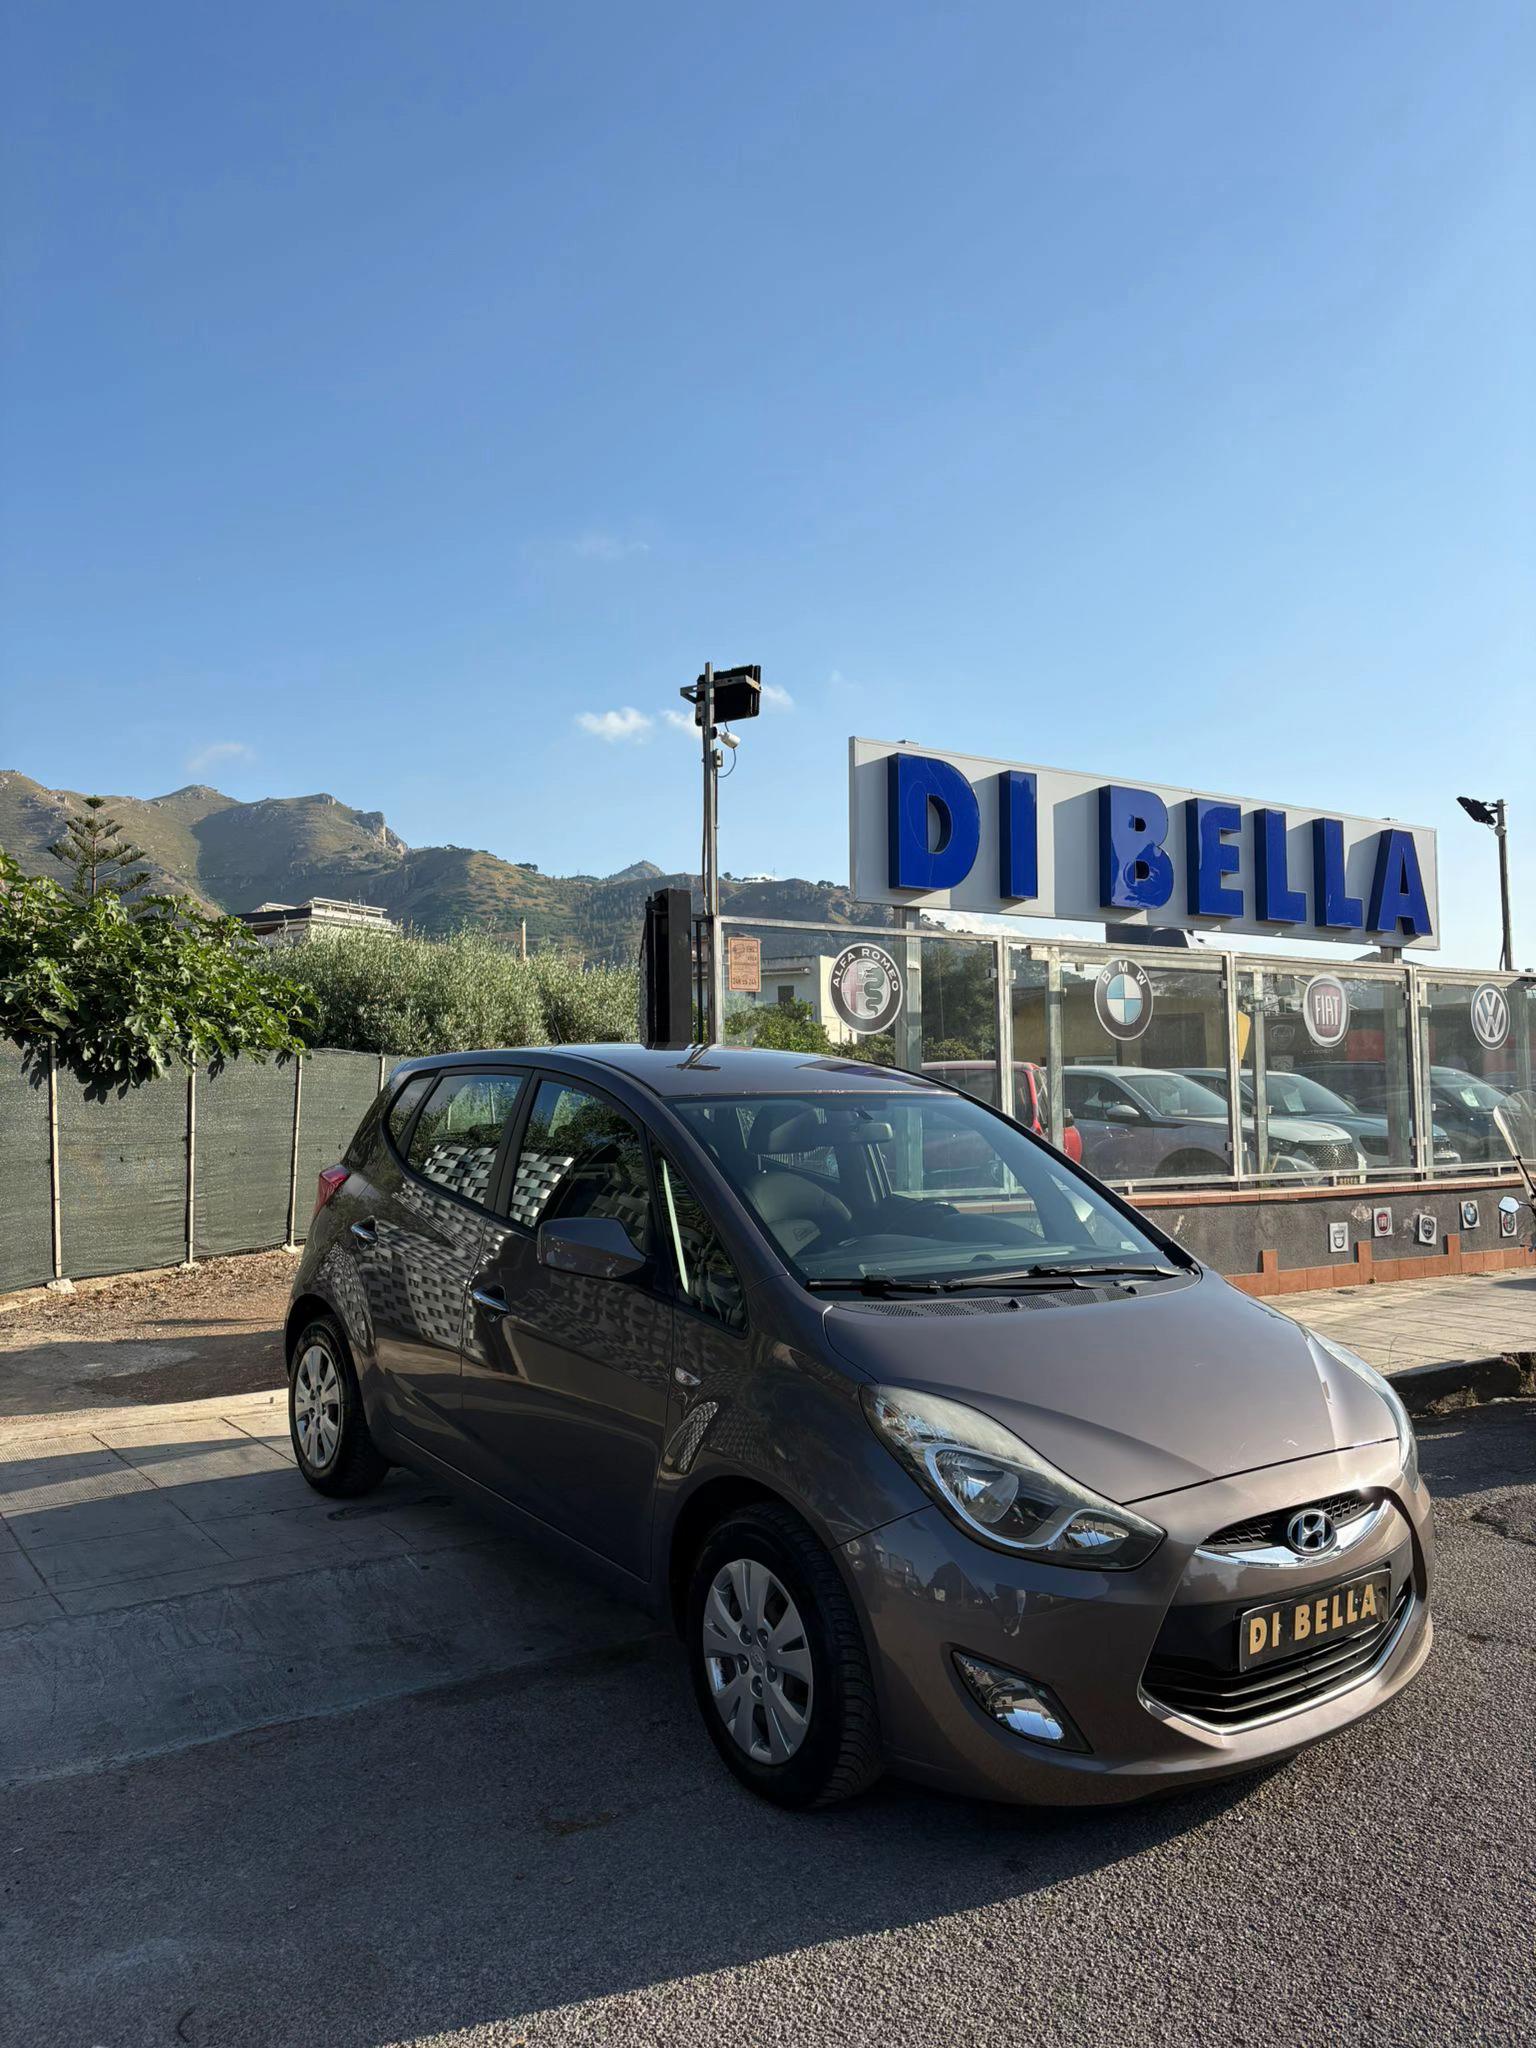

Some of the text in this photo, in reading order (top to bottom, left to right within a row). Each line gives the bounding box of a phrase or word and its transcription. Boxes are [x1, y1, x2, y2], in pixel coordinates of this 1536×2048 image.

[888, 752, 1432, 936] DI BELLA
[832, 948, 899, 991] ALFA ROMEO
[1101, 961, 1147, 985] BMW
[1315, 994, 1340, 1026] FIAT
[1249, 1583, 1377, 1655] DI BELLA
